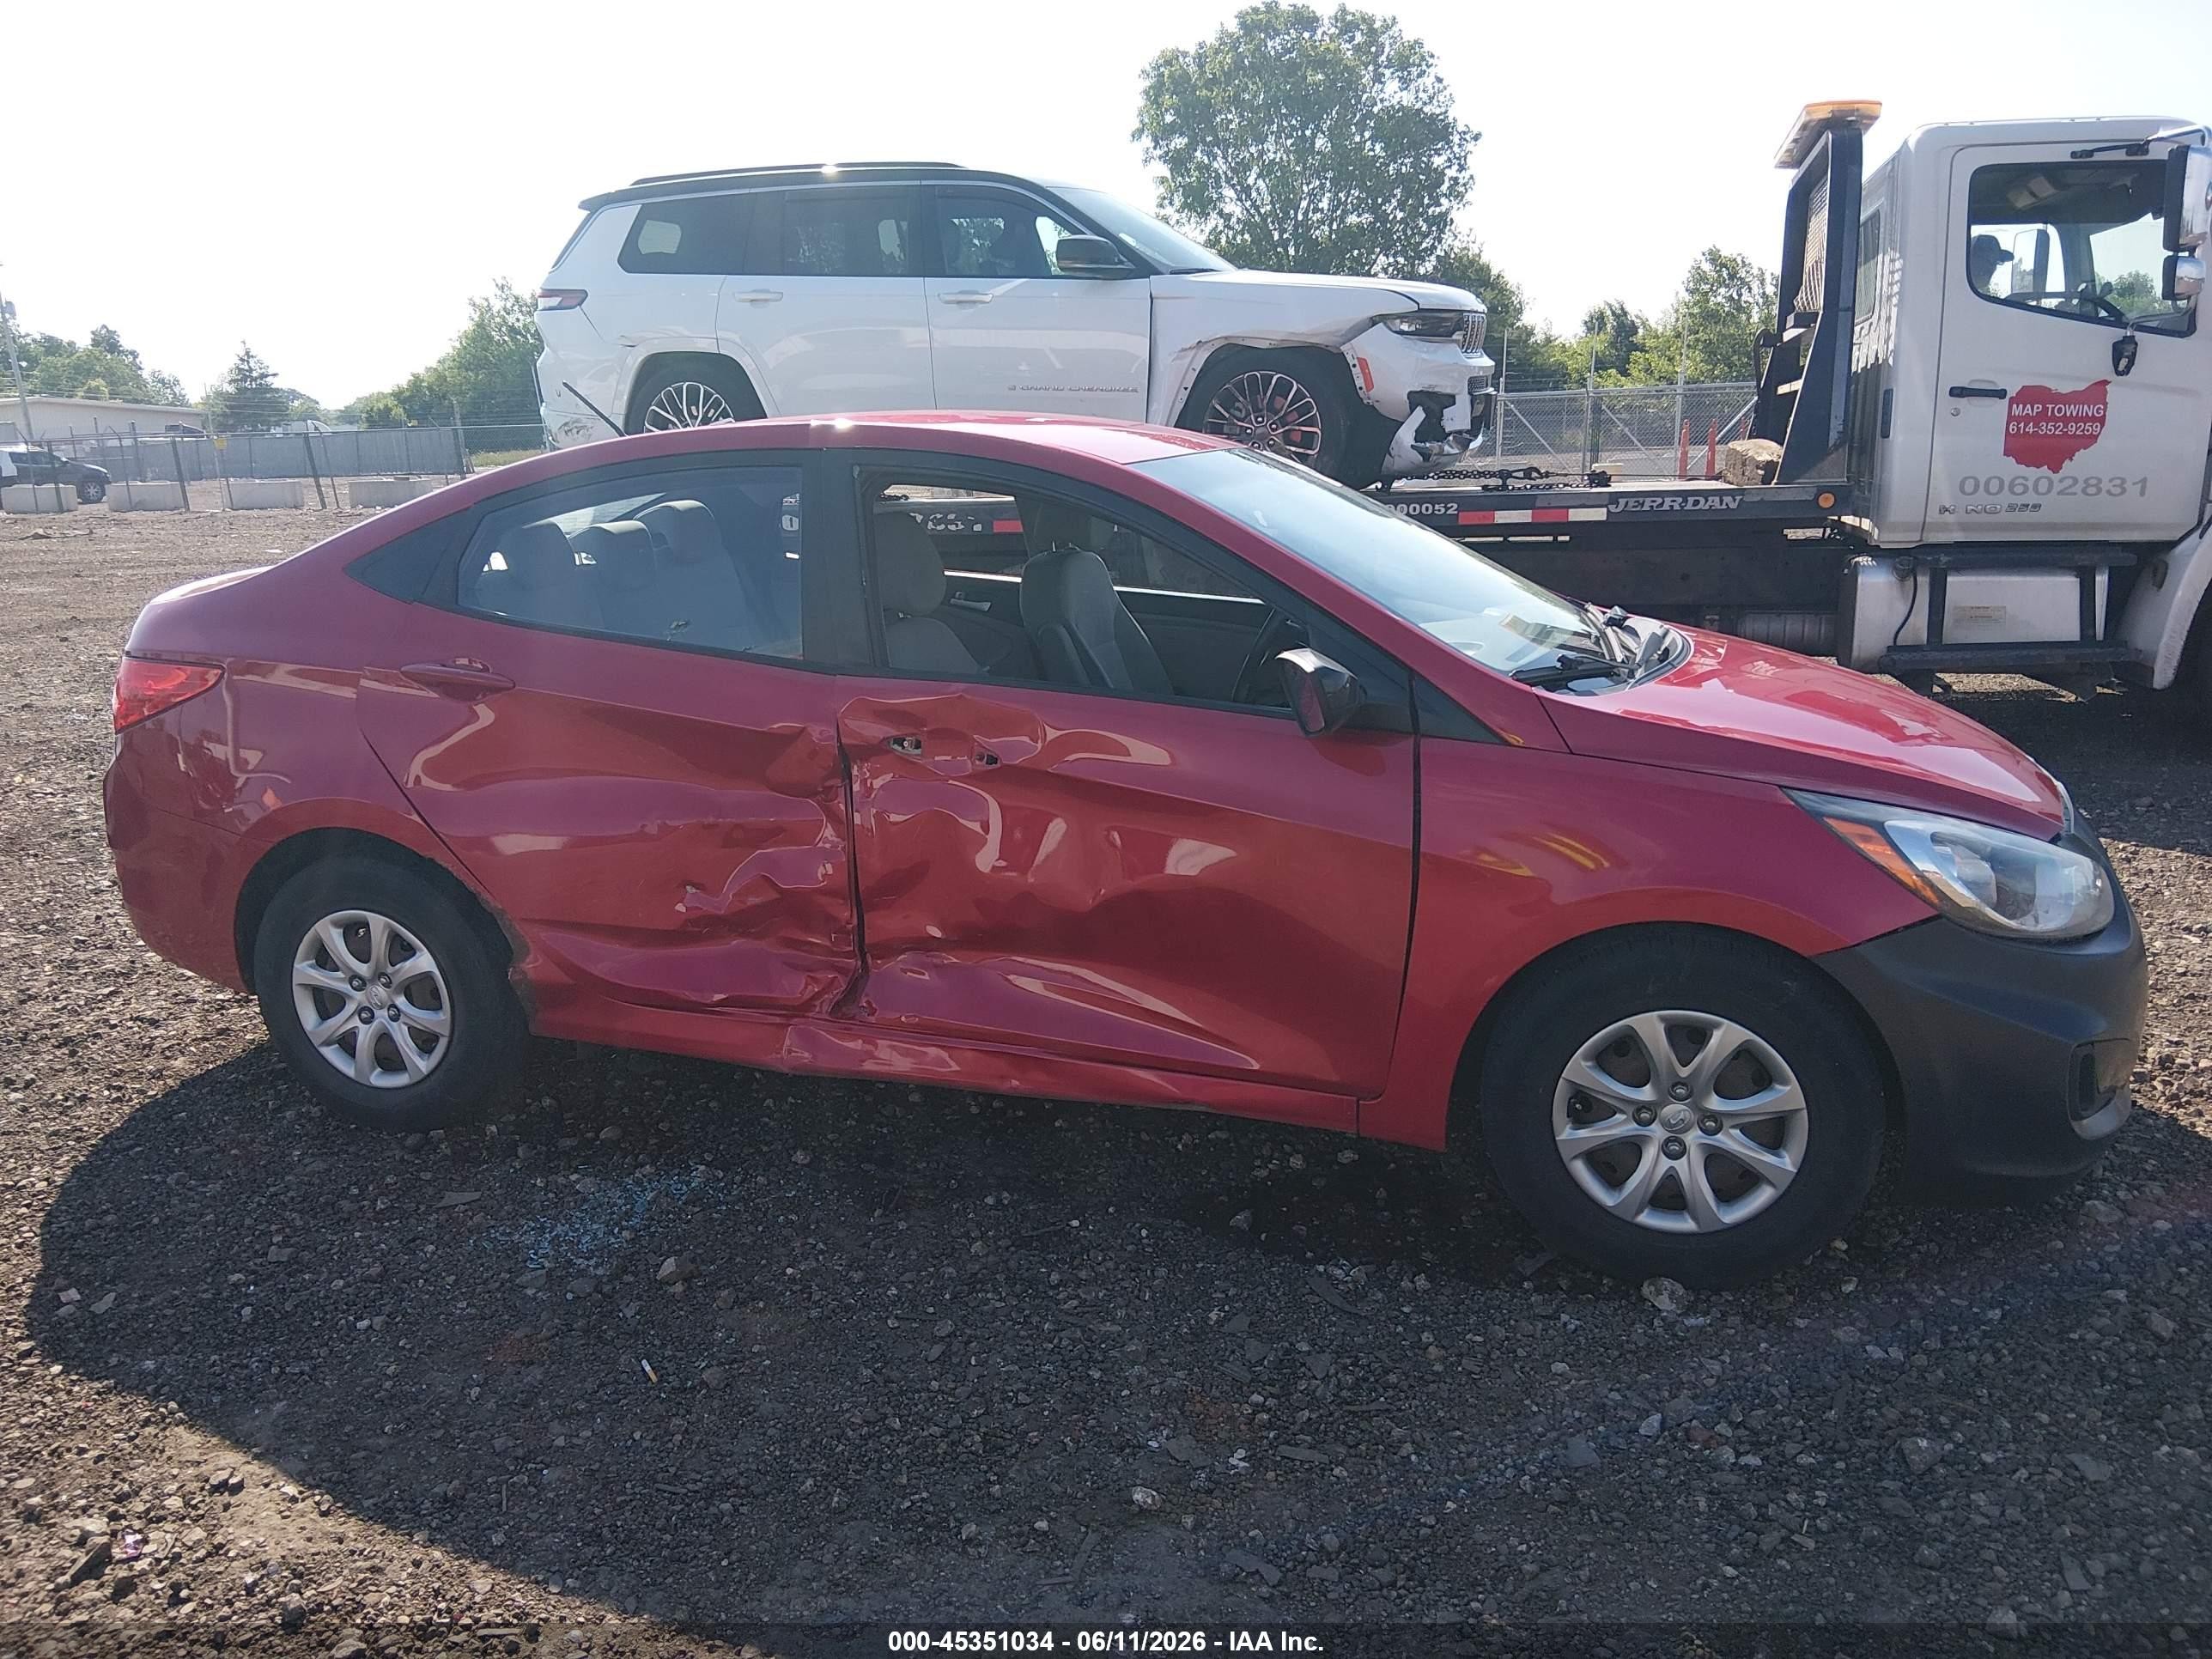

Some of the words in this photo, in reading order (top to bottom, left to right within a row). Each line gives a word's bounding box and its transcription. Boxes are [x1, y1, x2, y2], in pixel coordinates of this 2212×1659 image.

[2011, 404, 2043, 416] MAP
[2045, 404, 2104, 417] TOWING
[2008, 421, 2100, 435] 614-352-9259
[1958, 475, 2148, 497] 00602831
[1607, 495, 1744, 514] JERR-DAN
